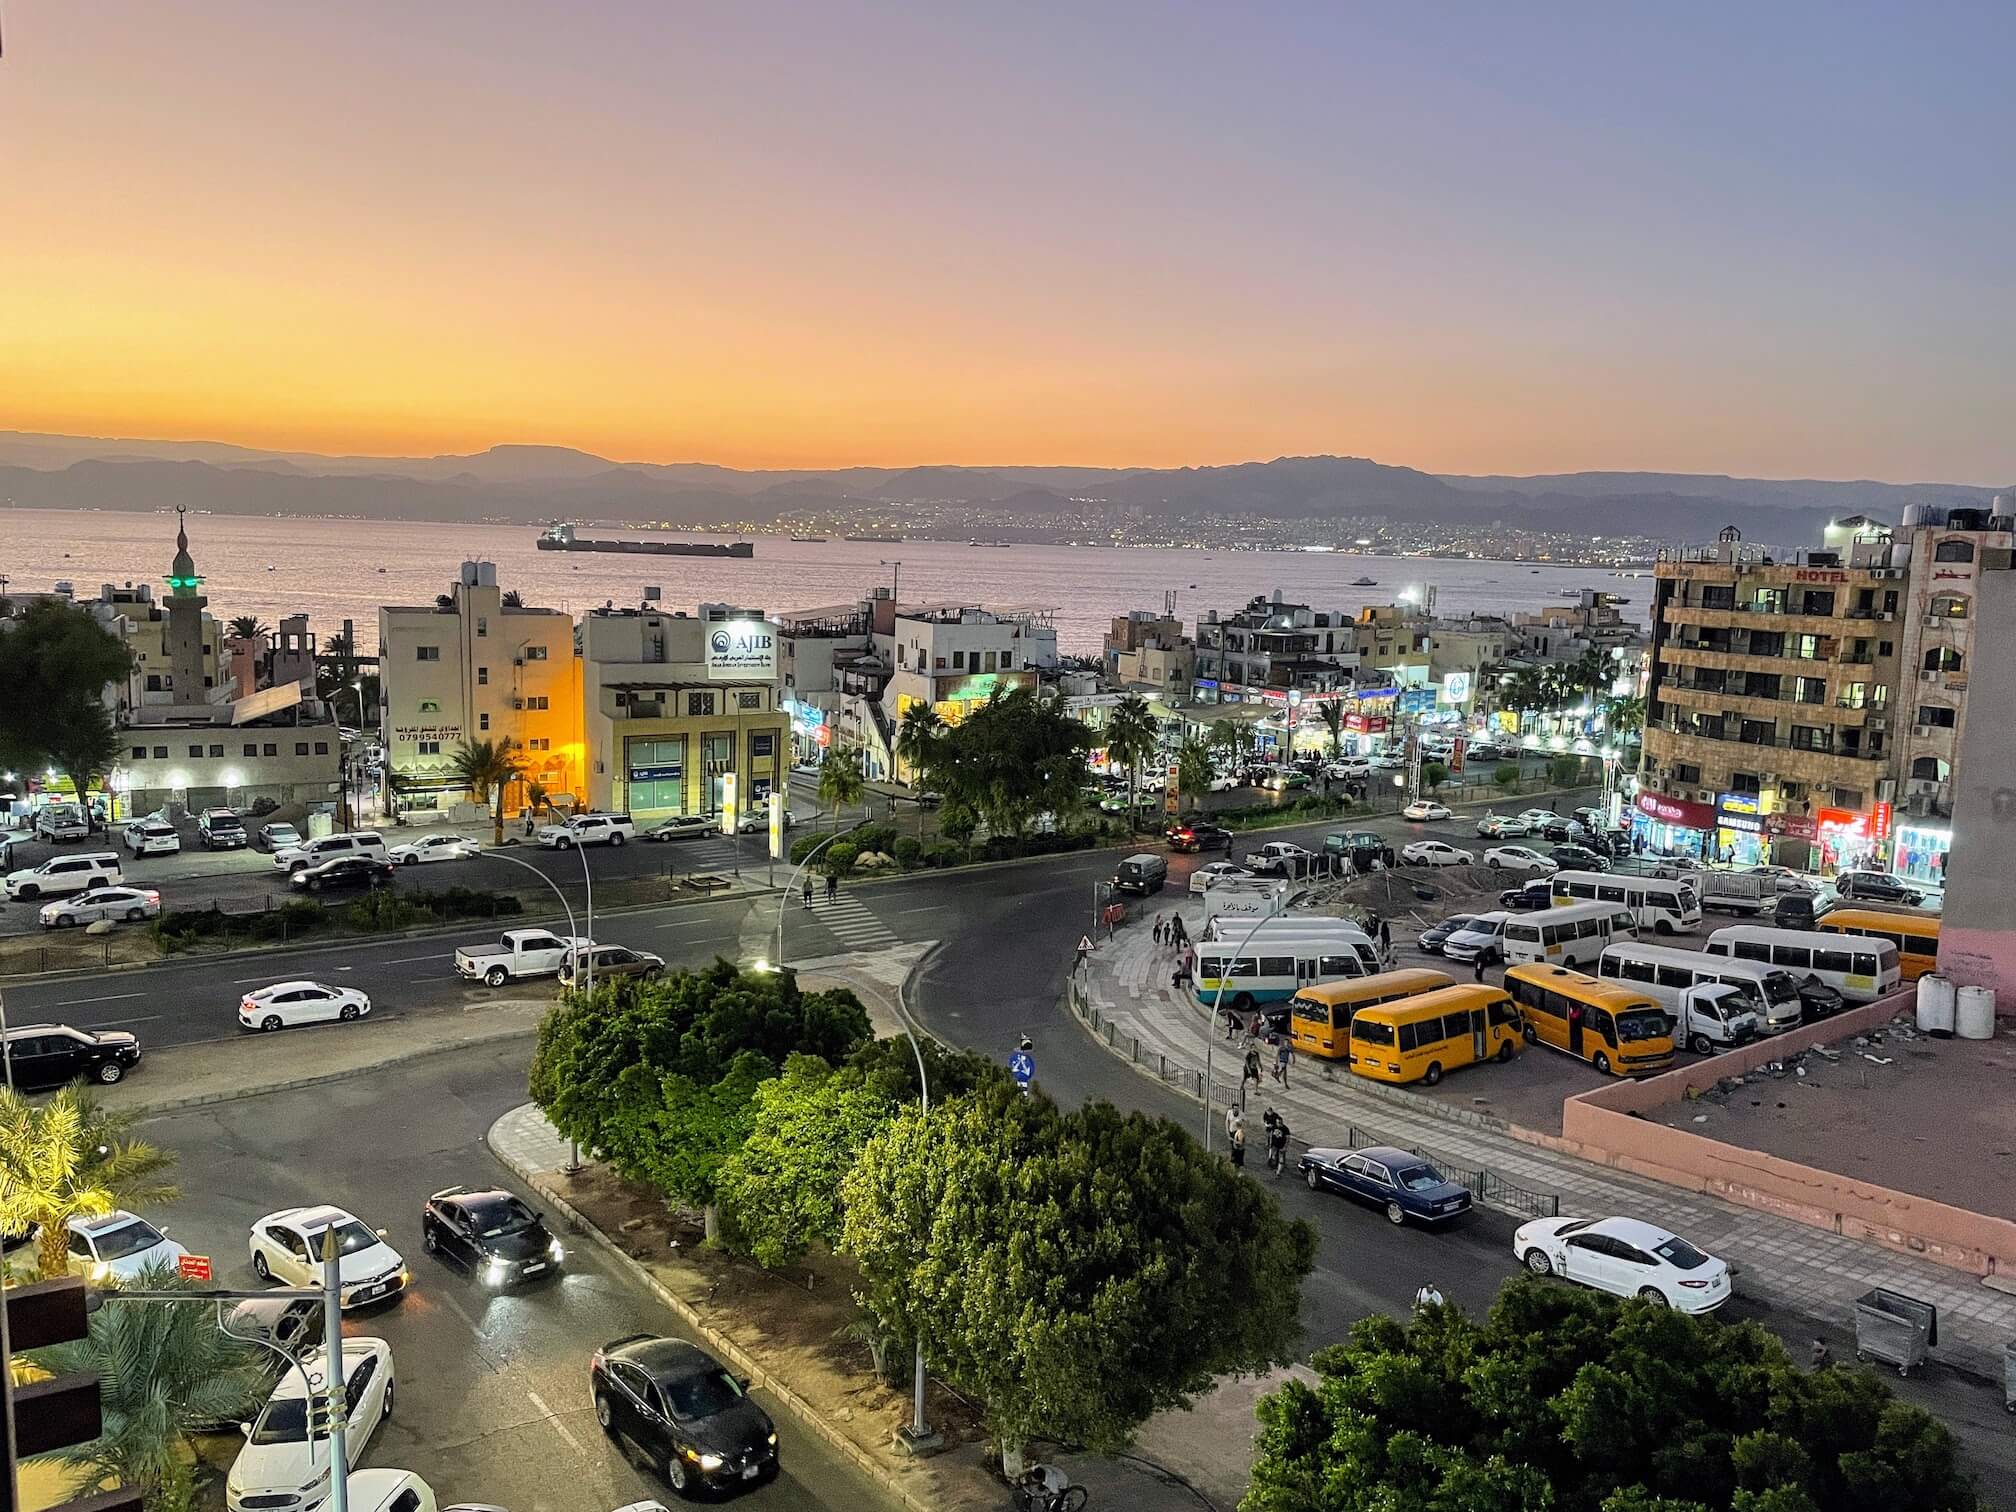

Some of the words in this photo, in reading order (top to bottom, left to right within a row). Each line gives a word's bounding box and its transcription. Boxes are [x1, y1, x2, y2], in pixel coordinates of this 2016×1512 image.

[1796, 570, 1849, 583] HOTEL
[736, 634, 771, 653] AJIB
[399, 733, 462, 741] 0799540777
[1717, 815, 1761, 832] SAMSUNG
